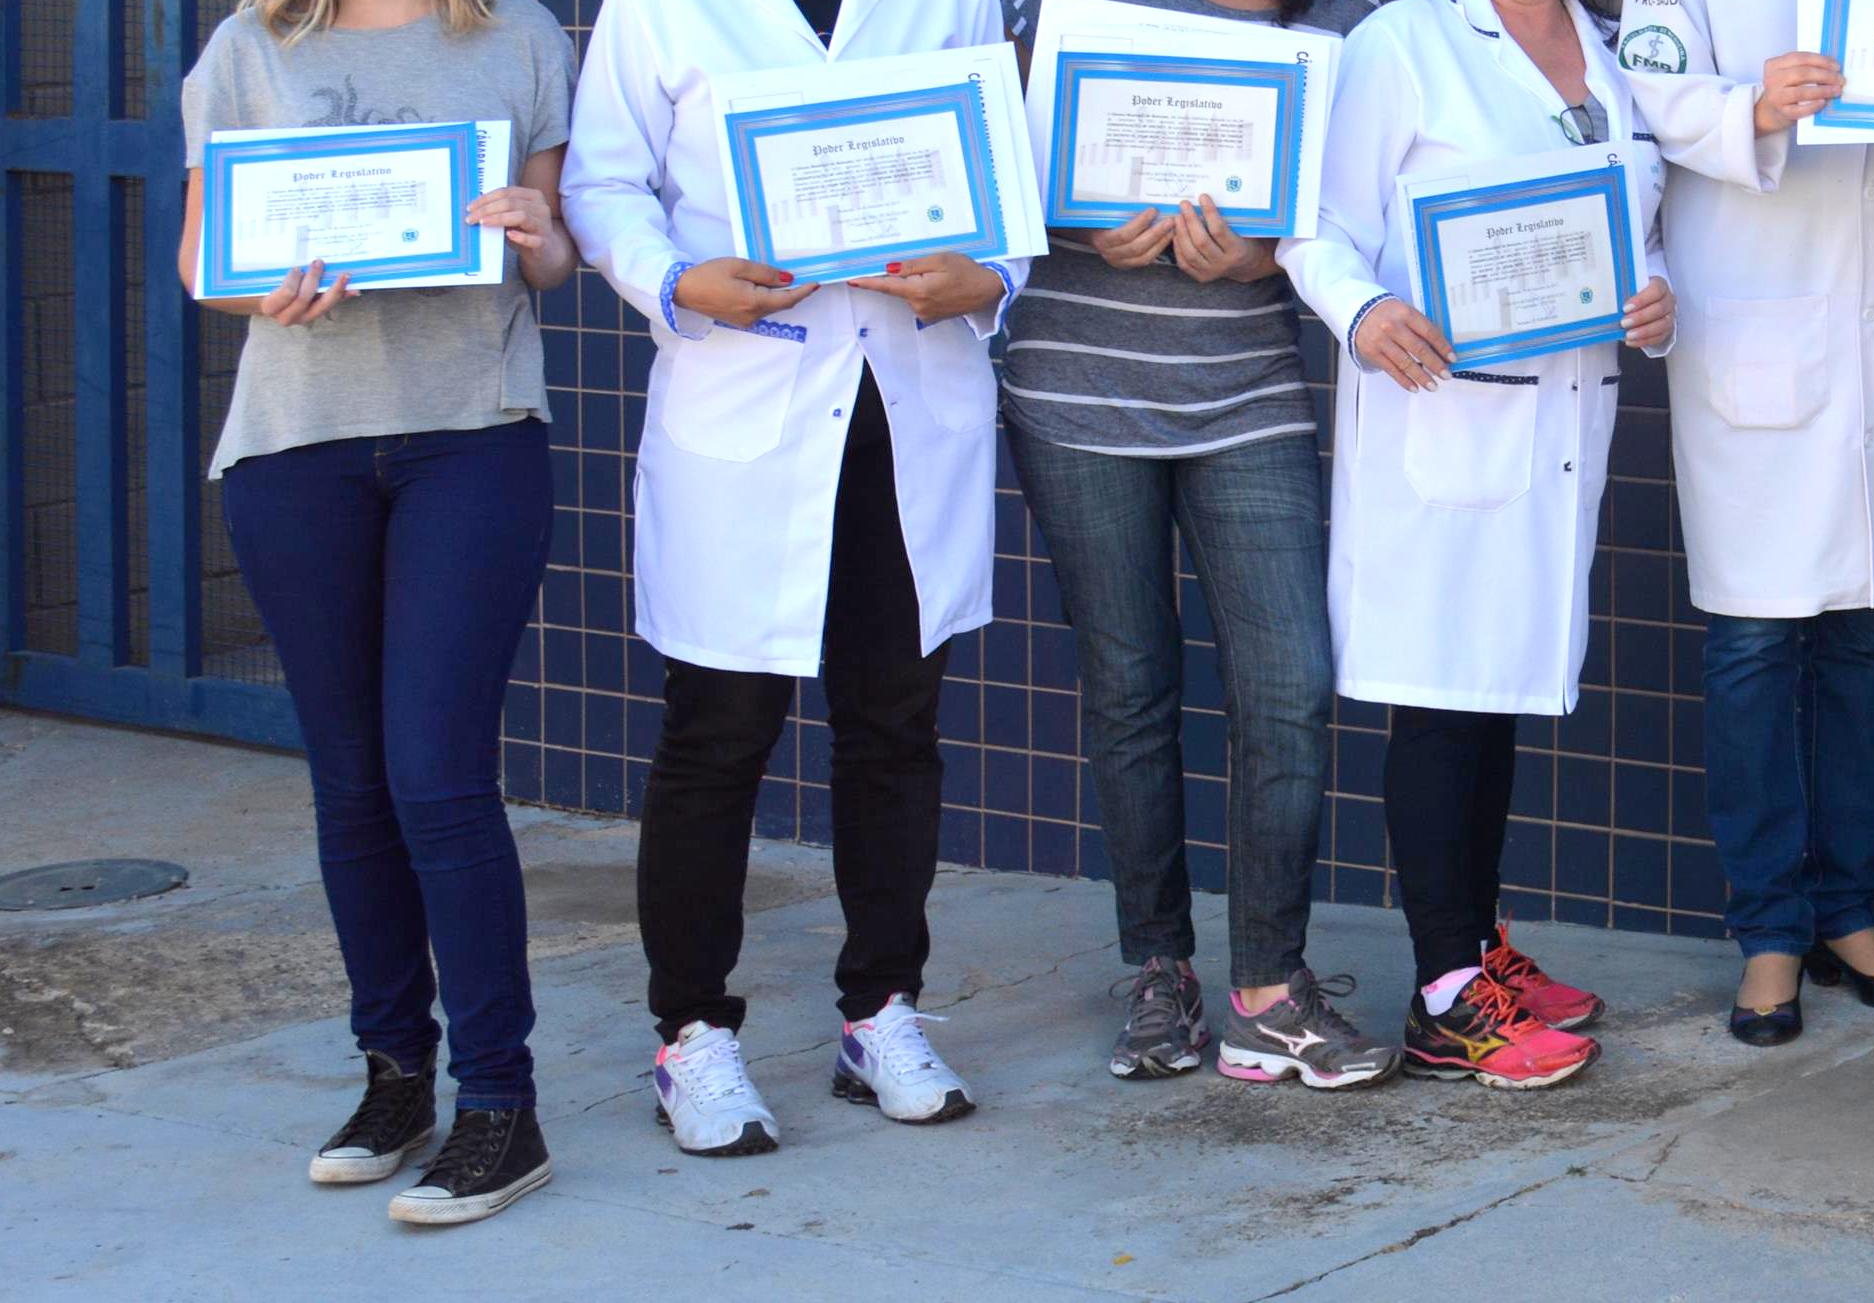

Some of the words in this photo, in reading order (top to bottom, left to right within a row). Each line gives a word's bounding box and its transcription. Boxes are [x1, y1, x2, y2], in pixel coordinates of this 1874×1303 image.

[1132, 95, 1162, 106] Poder
[1166, 96, 1223, 109] Legislativo
[812, 143, 845, 157] Poder
[847, 136, 905, 151] Legislativo
[292, 171, 326, 183] Poder
[331, 167, 392, 179] Legislativo
[1486, 225, 1514, 239] Poder
[1517, 218, 1564, 234] Legislativo
